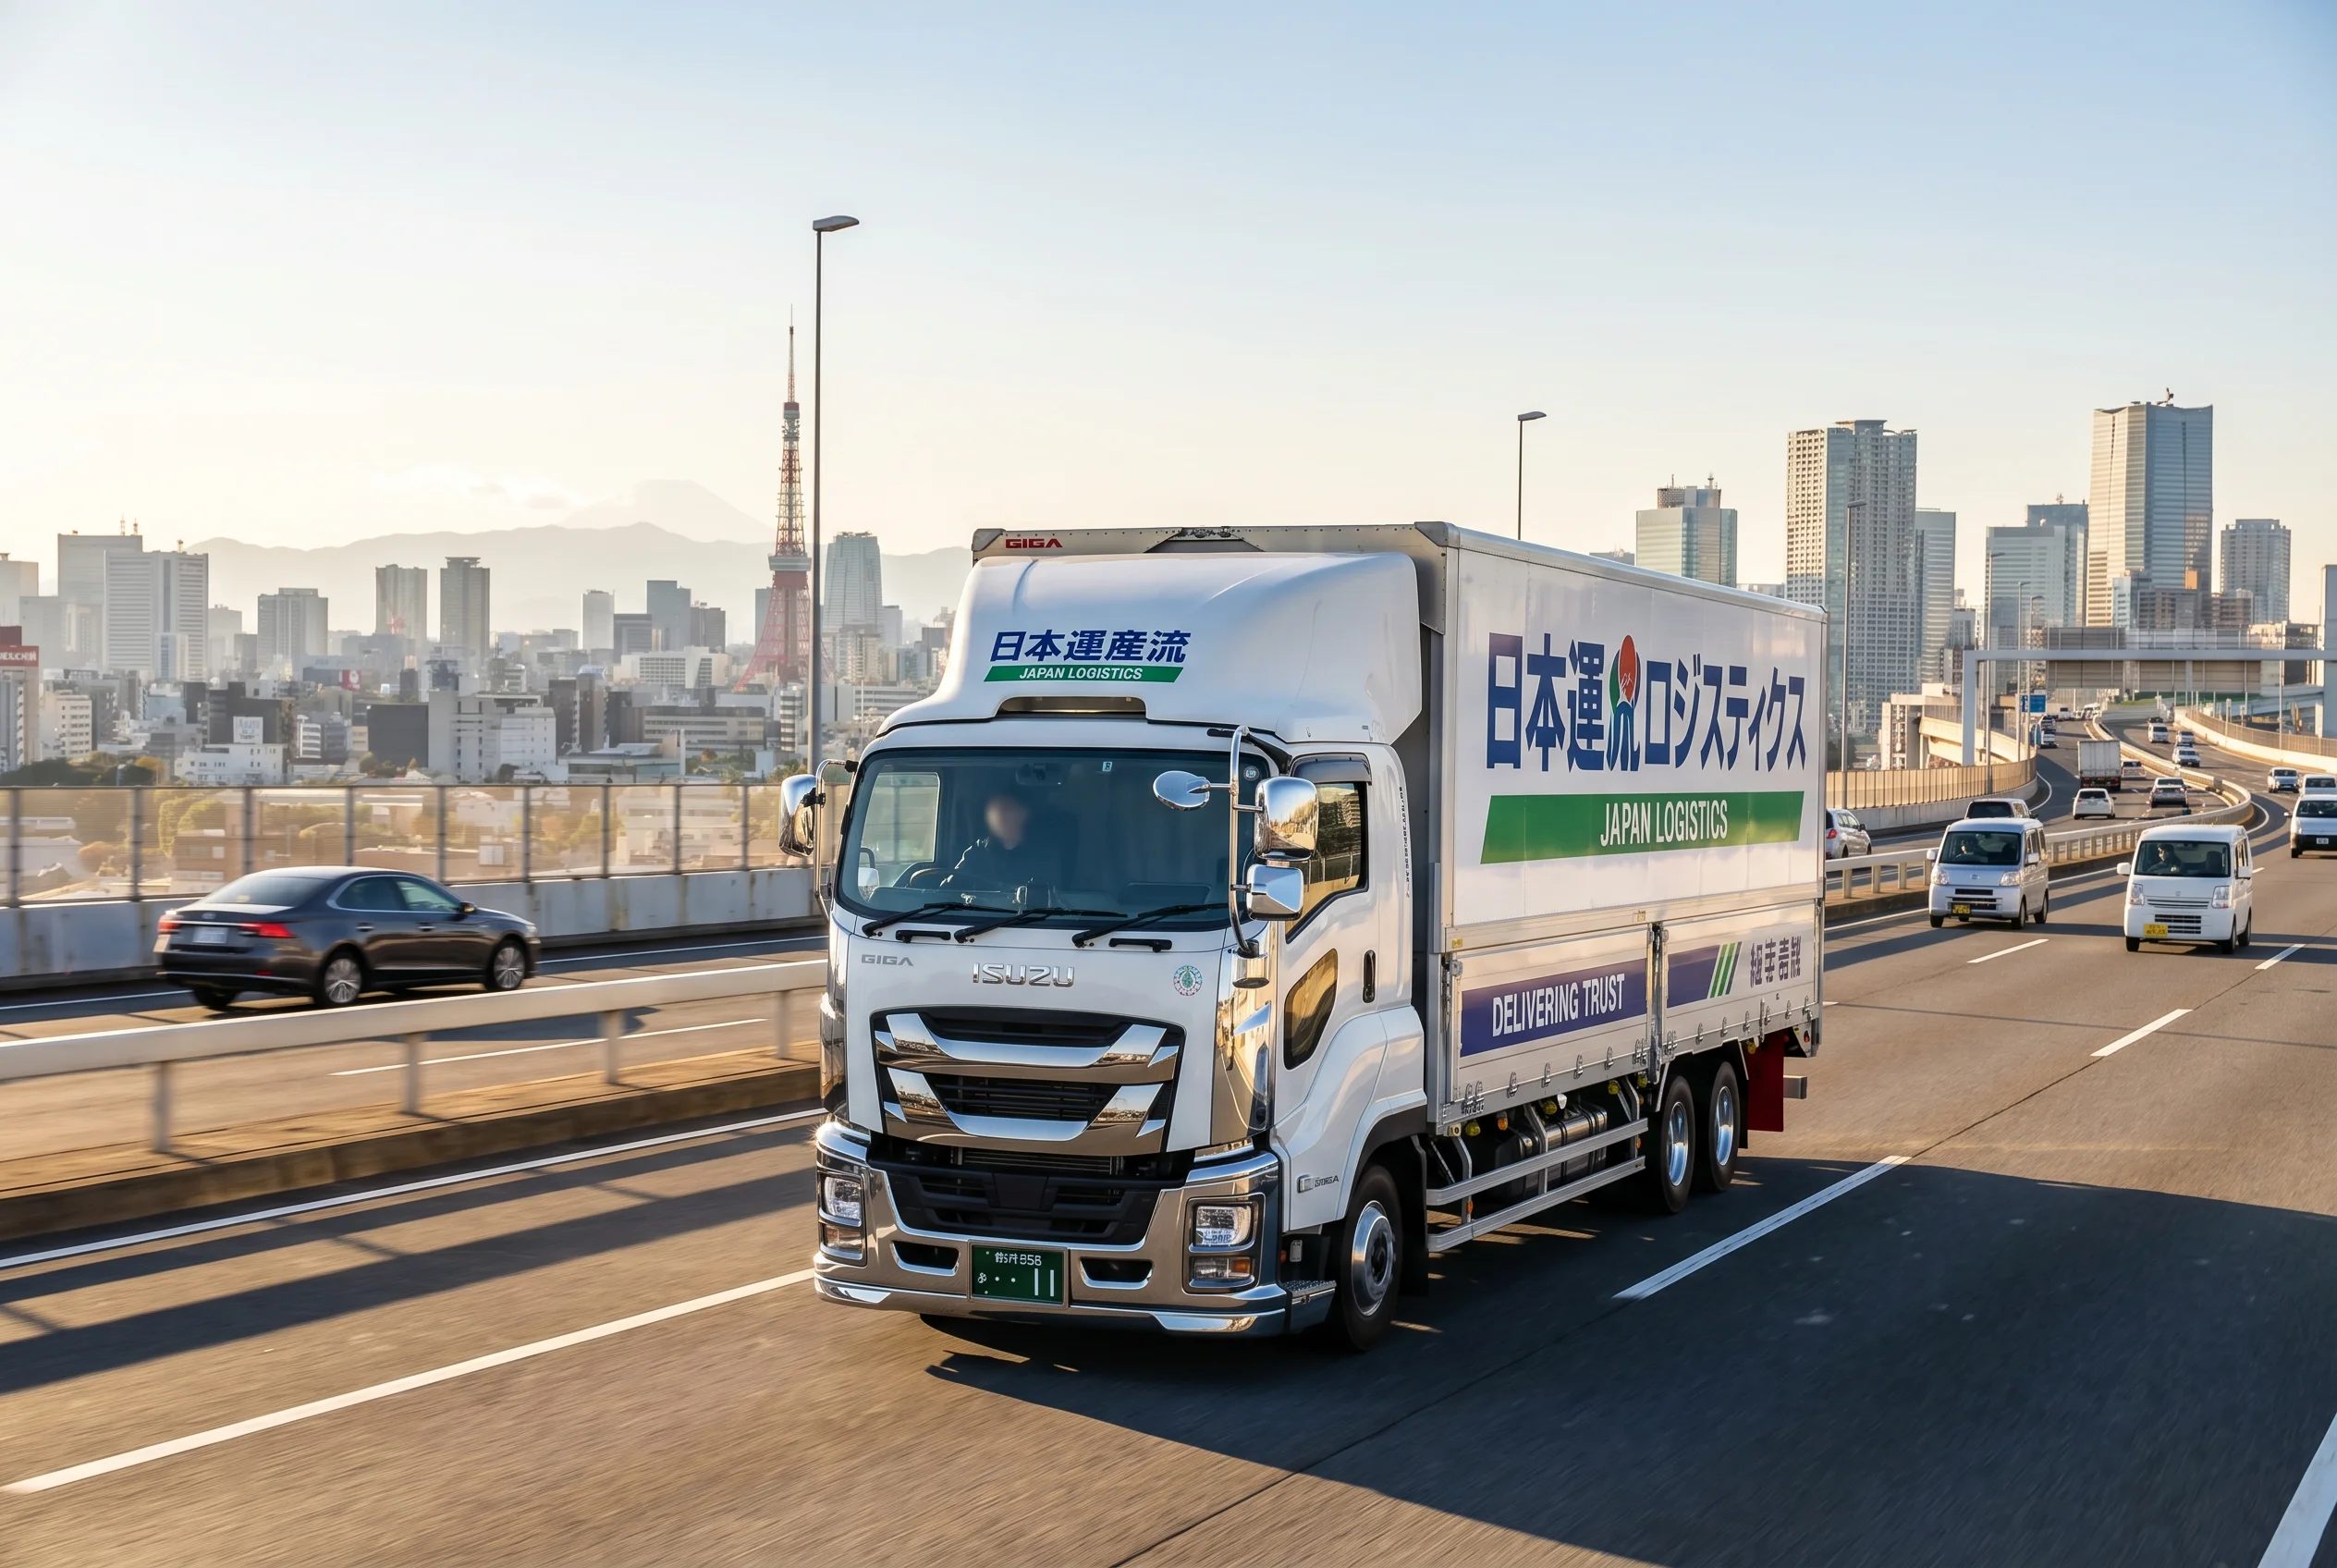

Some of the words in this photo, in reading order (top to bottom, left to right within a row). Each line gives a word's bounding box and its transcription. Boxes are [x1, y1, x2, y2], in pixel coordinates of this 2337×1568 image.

[1005, 538, 1063, 549] GIGA
[989, 629, 1192, 664] 日本運産流
[1019, 667, 1065, 680] JAPAN
[1067, 667, 1144, 680] LOGISTICS
[1599, 802, 1651, 847] JAPAN
[1656, 799, 1728, 843] LOGISTICS
[861, 953, 914, 967] GIGA
[973, 962, 1075, 987] ISUZU
[1491, 981, 1579, 1037] DELIVERING
[1582, 973, 1625, 1017] TRUST
